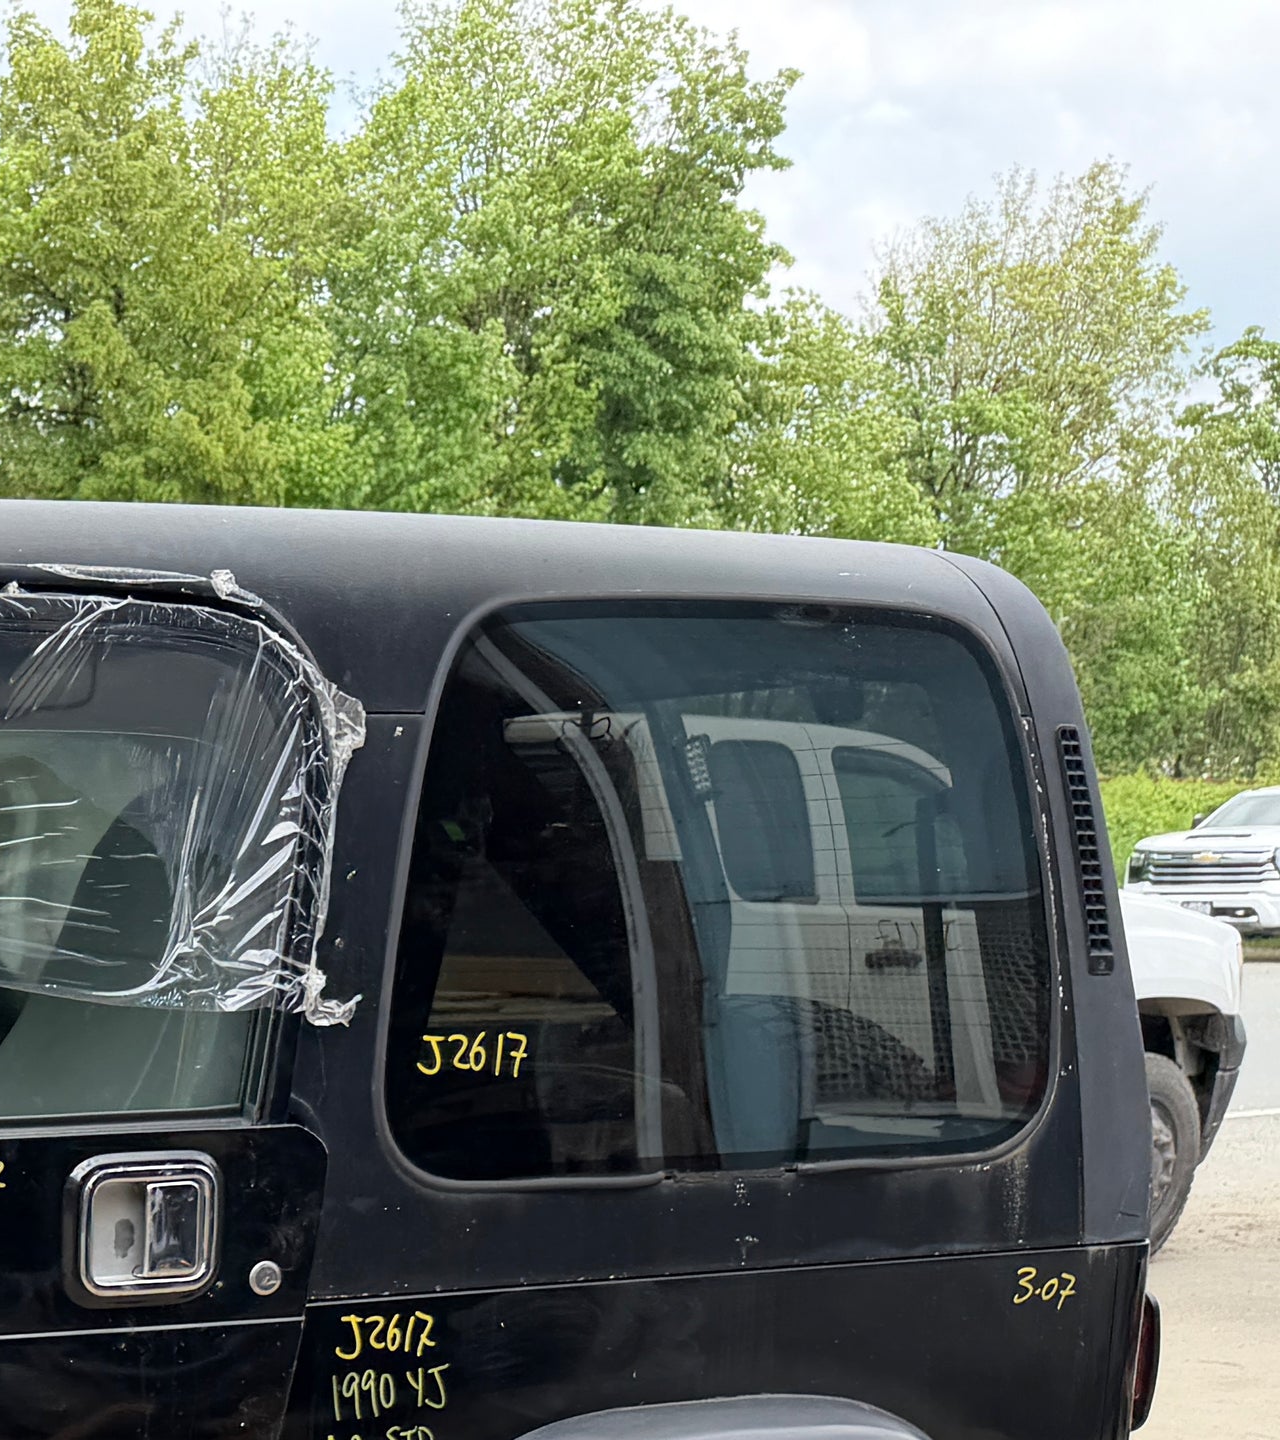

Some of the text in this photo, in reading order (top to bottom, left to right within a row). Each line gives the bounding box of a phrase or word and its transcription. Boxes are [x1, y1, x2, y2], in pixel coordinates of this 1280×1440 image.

[416, 1031, 528, 1078] J2617
[335, 1311, 436, 1360] J2617
[332, 1363, 451, 1421] 1990 YJ
